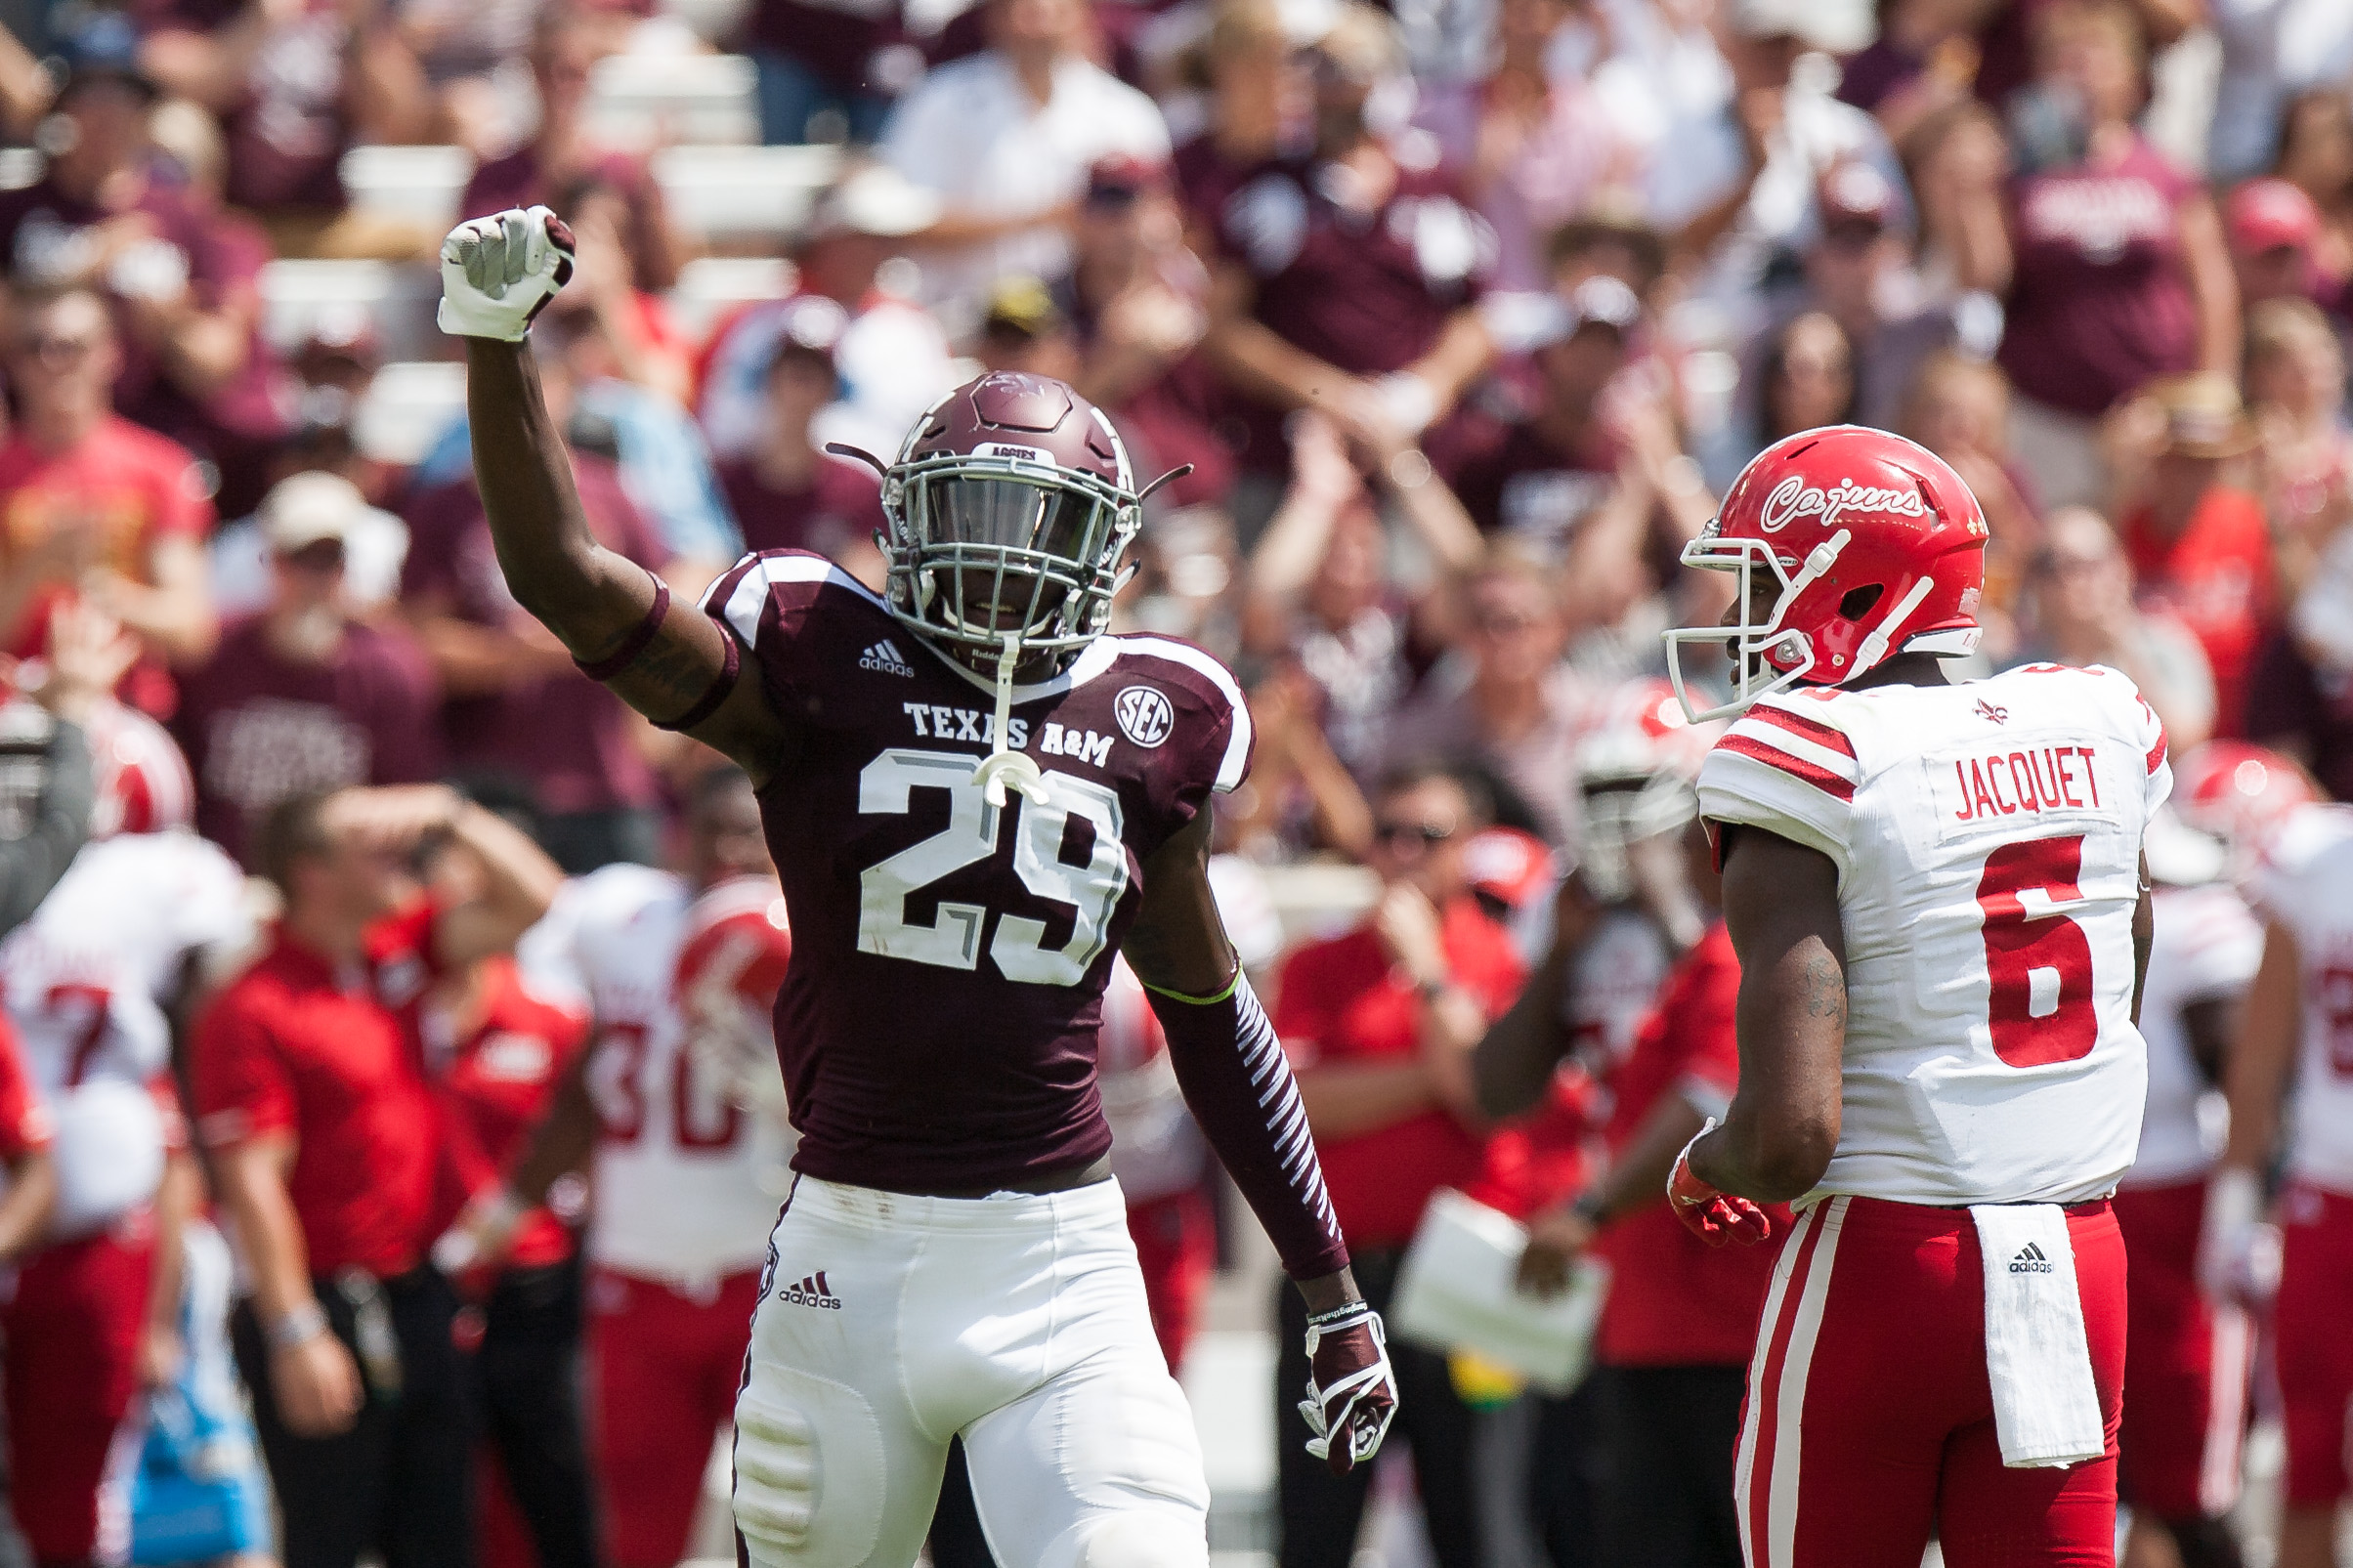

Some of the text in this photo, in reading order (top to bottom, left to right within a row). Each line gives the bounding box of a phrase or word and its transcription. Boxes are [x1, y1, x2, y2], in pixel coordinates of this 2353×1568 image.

[1761, 475, 1924, 533] Cajuns
[859, 657, 915, 678] adidas
[1119, 690, 1170, 742] SEC
[1041, 723, 1115, 768] A&M
[1955, 746, 2099, 821] JACQUET
[856, 748, 1131, 988] 29
[1976, 834, 2098, 1068] 6
[2009, 1257, 2052, 1273] adidas
[779, 1290, 841, 1310] adidas
